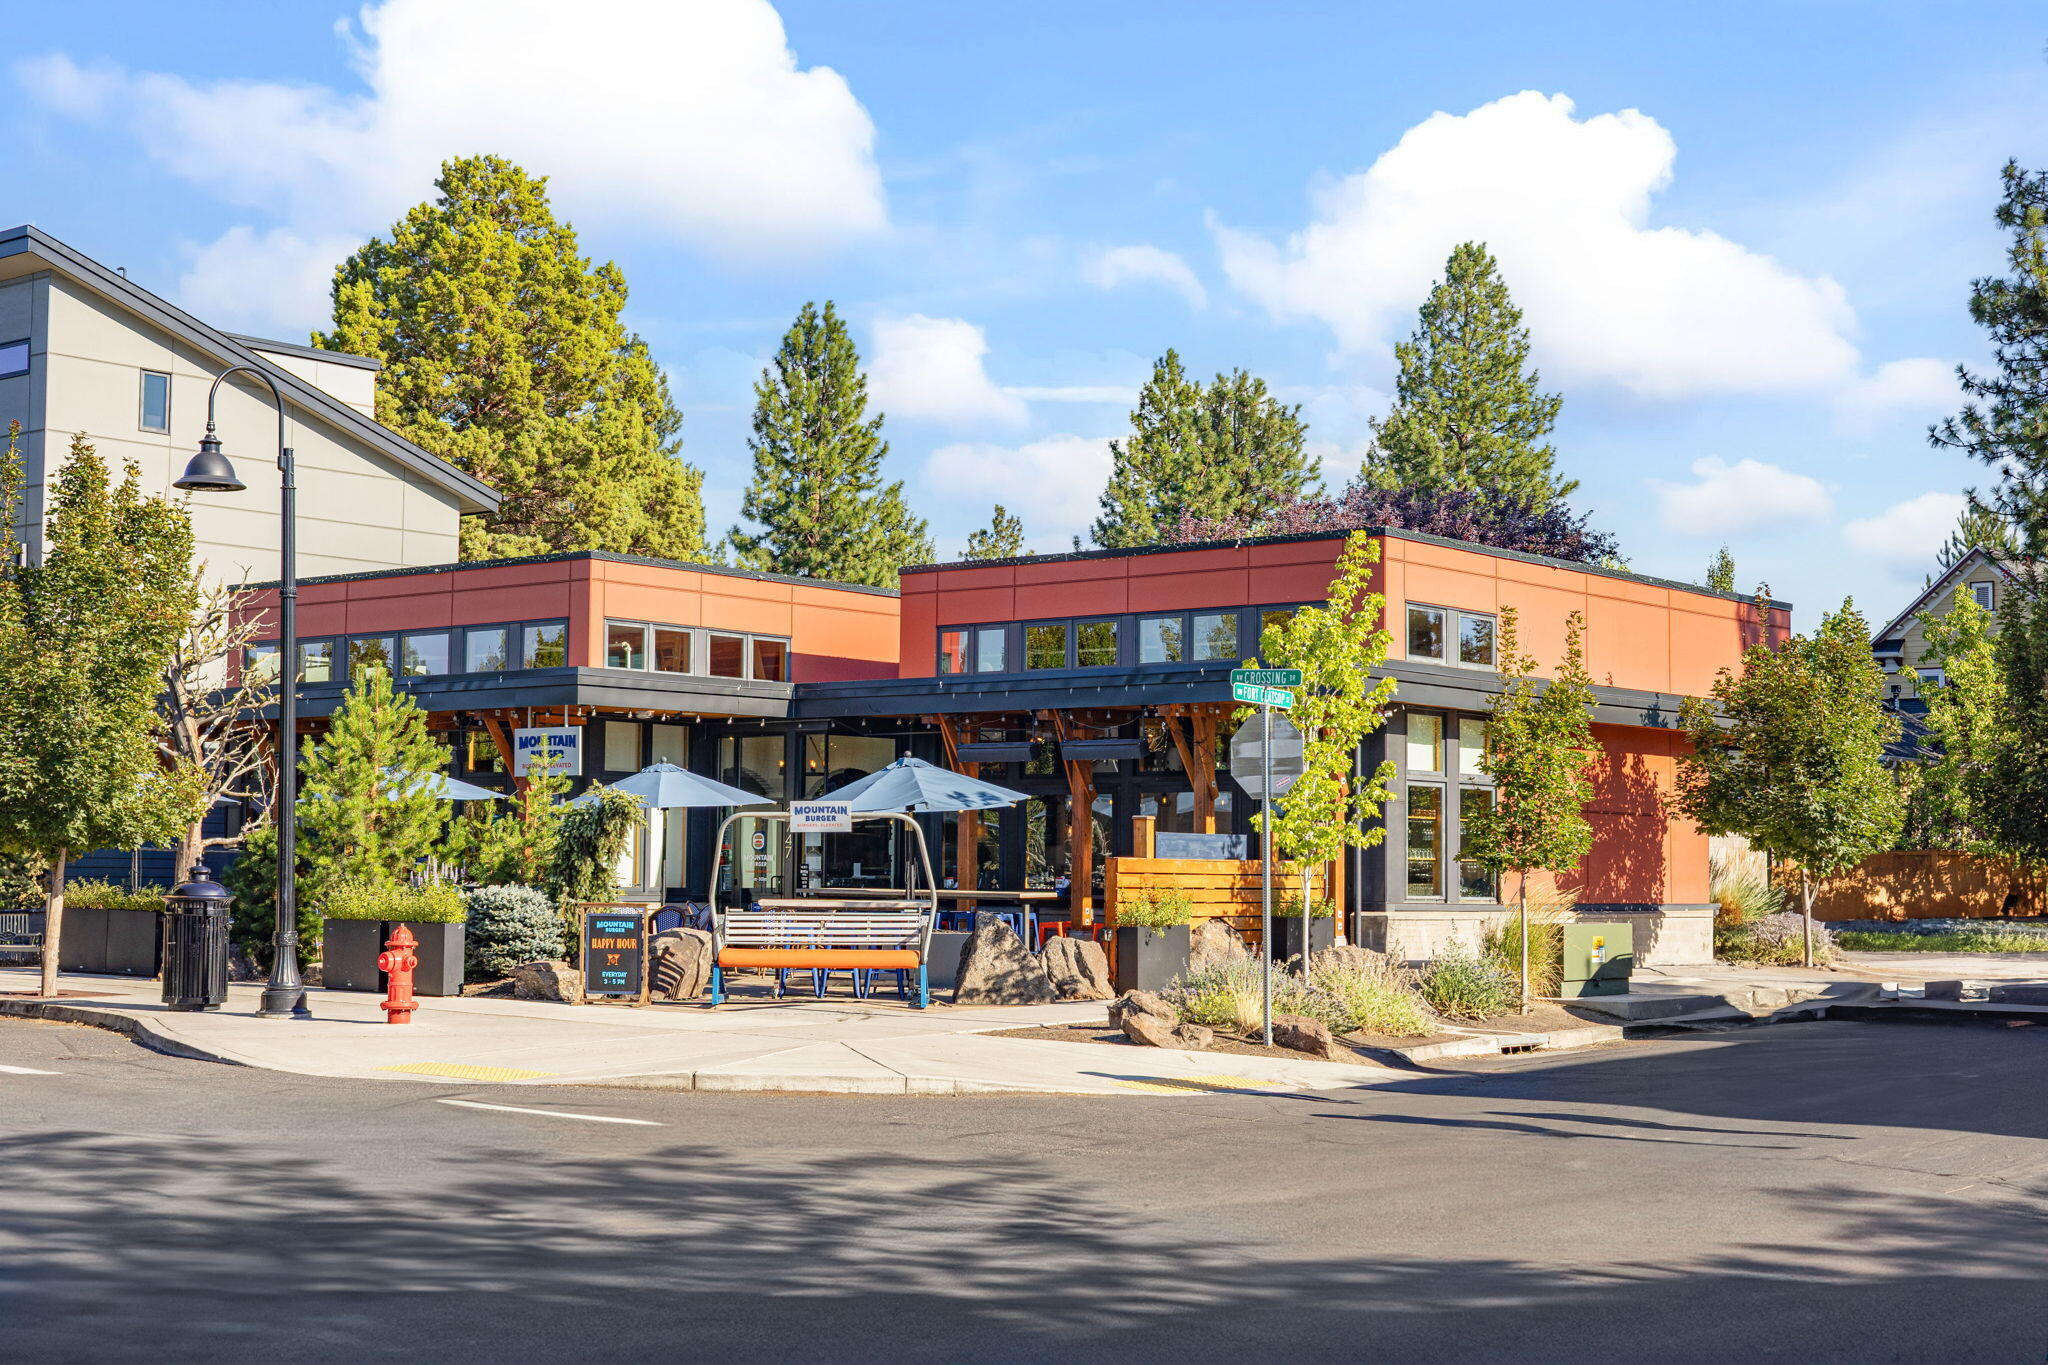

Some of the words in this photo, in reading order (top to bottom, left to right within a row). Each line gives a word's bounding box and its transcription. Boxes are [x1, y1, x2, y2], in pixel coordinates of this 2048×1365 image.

[1244, 671, 1287, 684] CROSSING
[1243, 686, 1259, 701] FORT
[1261, 688, 1286, 704] CLATSOP
[794, 806, 848, 815] MOUNTAIN
[596, 921, 634, 929] MOUNTAIN
[592, 938, 615, 949] HAPPY
[617, 938, 637, 949] HOUR
